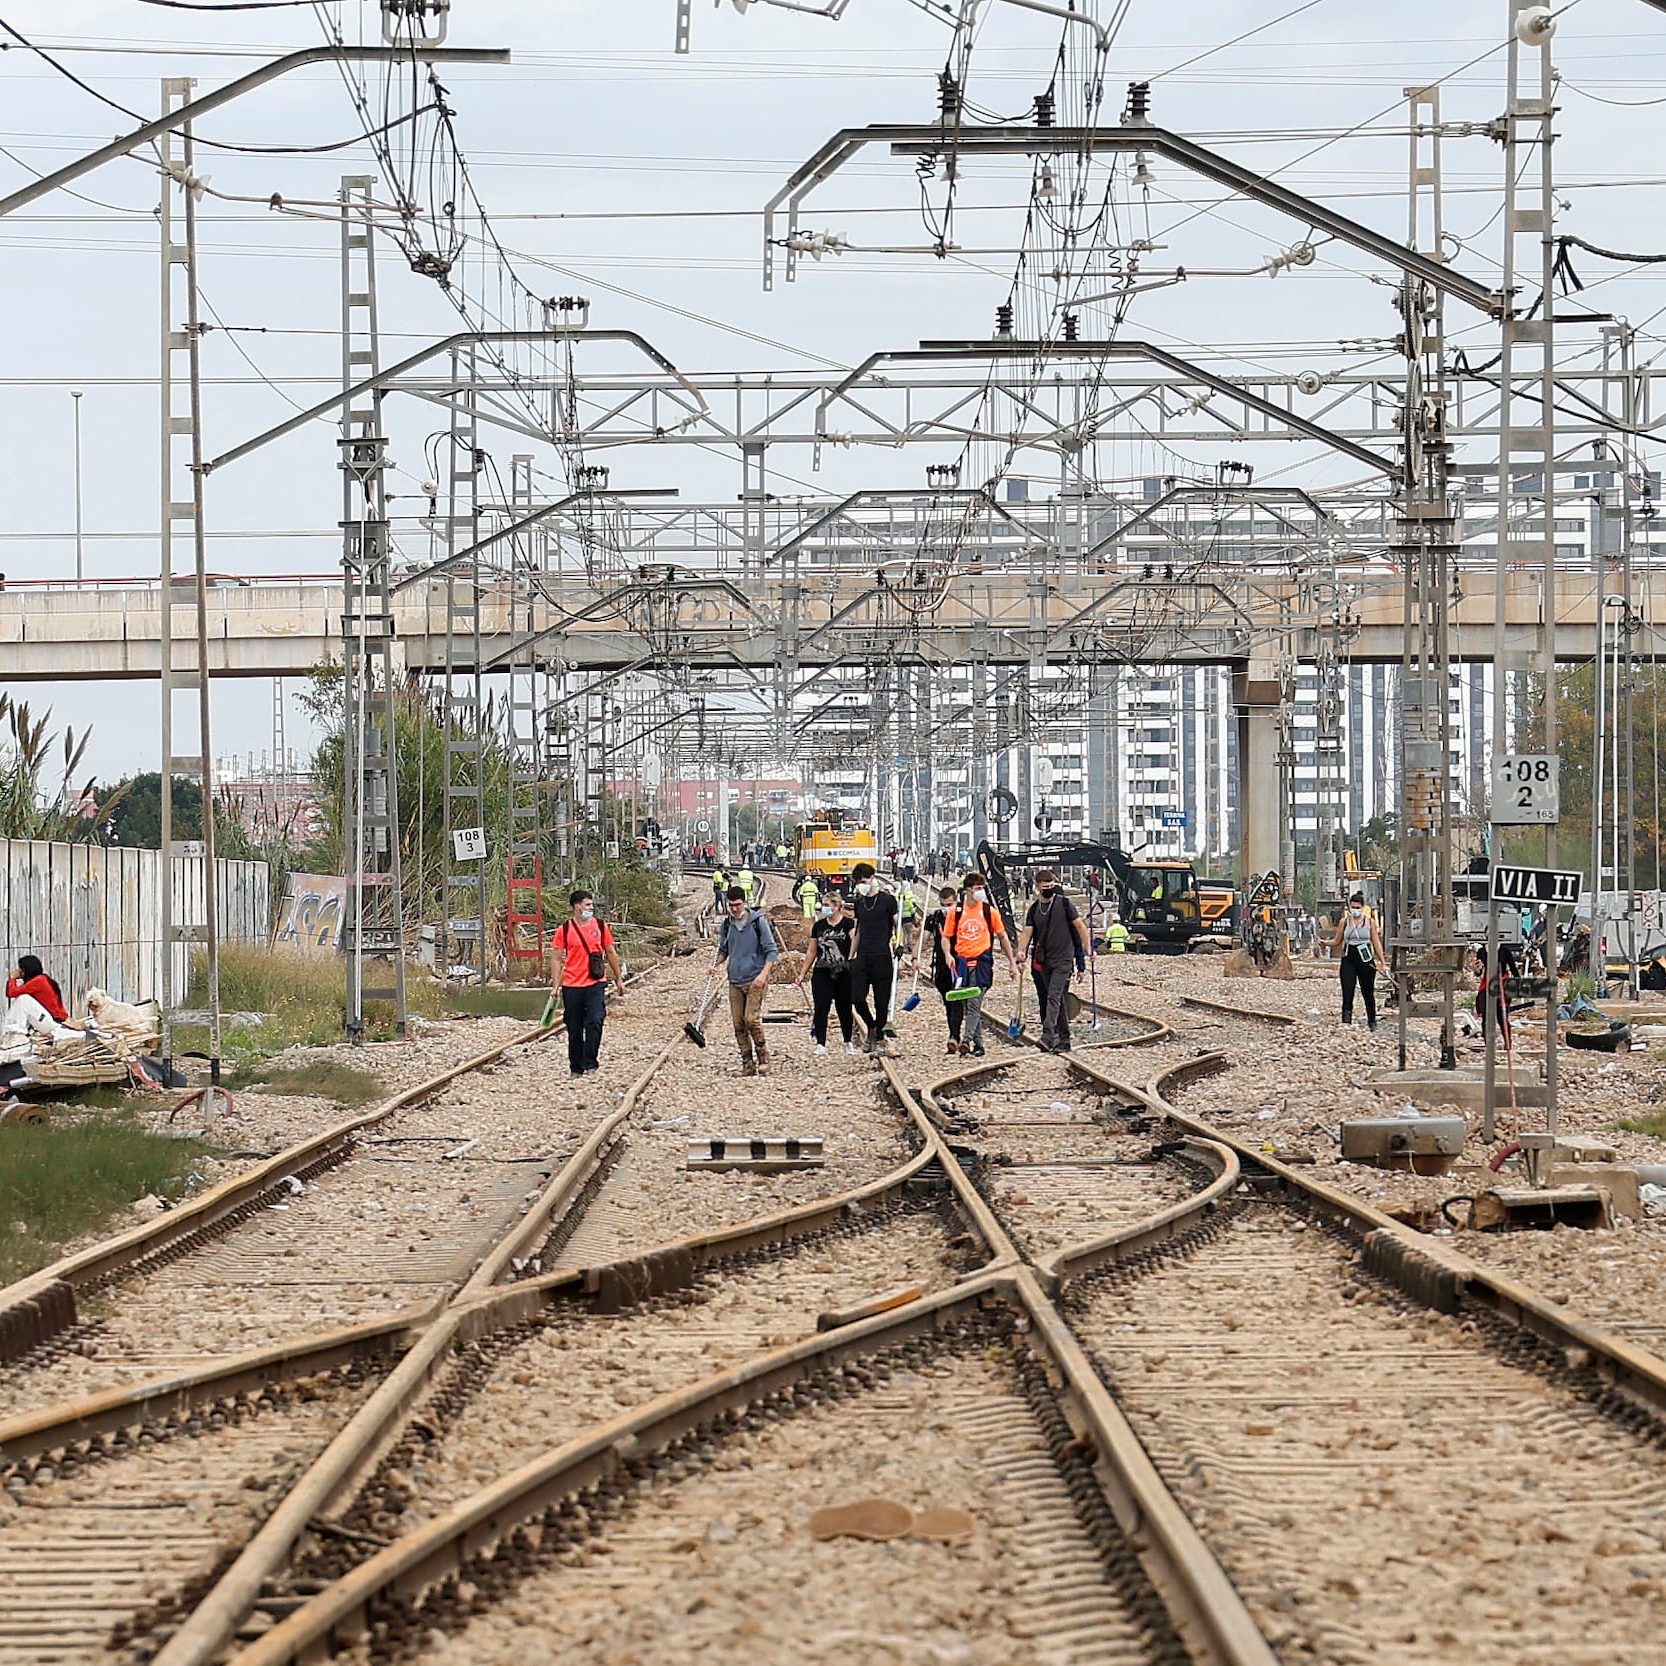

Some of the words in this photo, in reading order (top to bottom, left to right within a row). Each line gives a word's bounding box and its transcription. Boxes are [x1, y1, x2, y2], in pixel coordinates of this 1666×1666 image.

[1500, 760, 1550, 783] 108
[1516, 786, 1533, 807] 2
[457, 830, 480, 843] 108
[466, 843, 475, 853] 3
[1500, 870, 1539, 898] VIA
[1551, 874, 1577, 901] II
